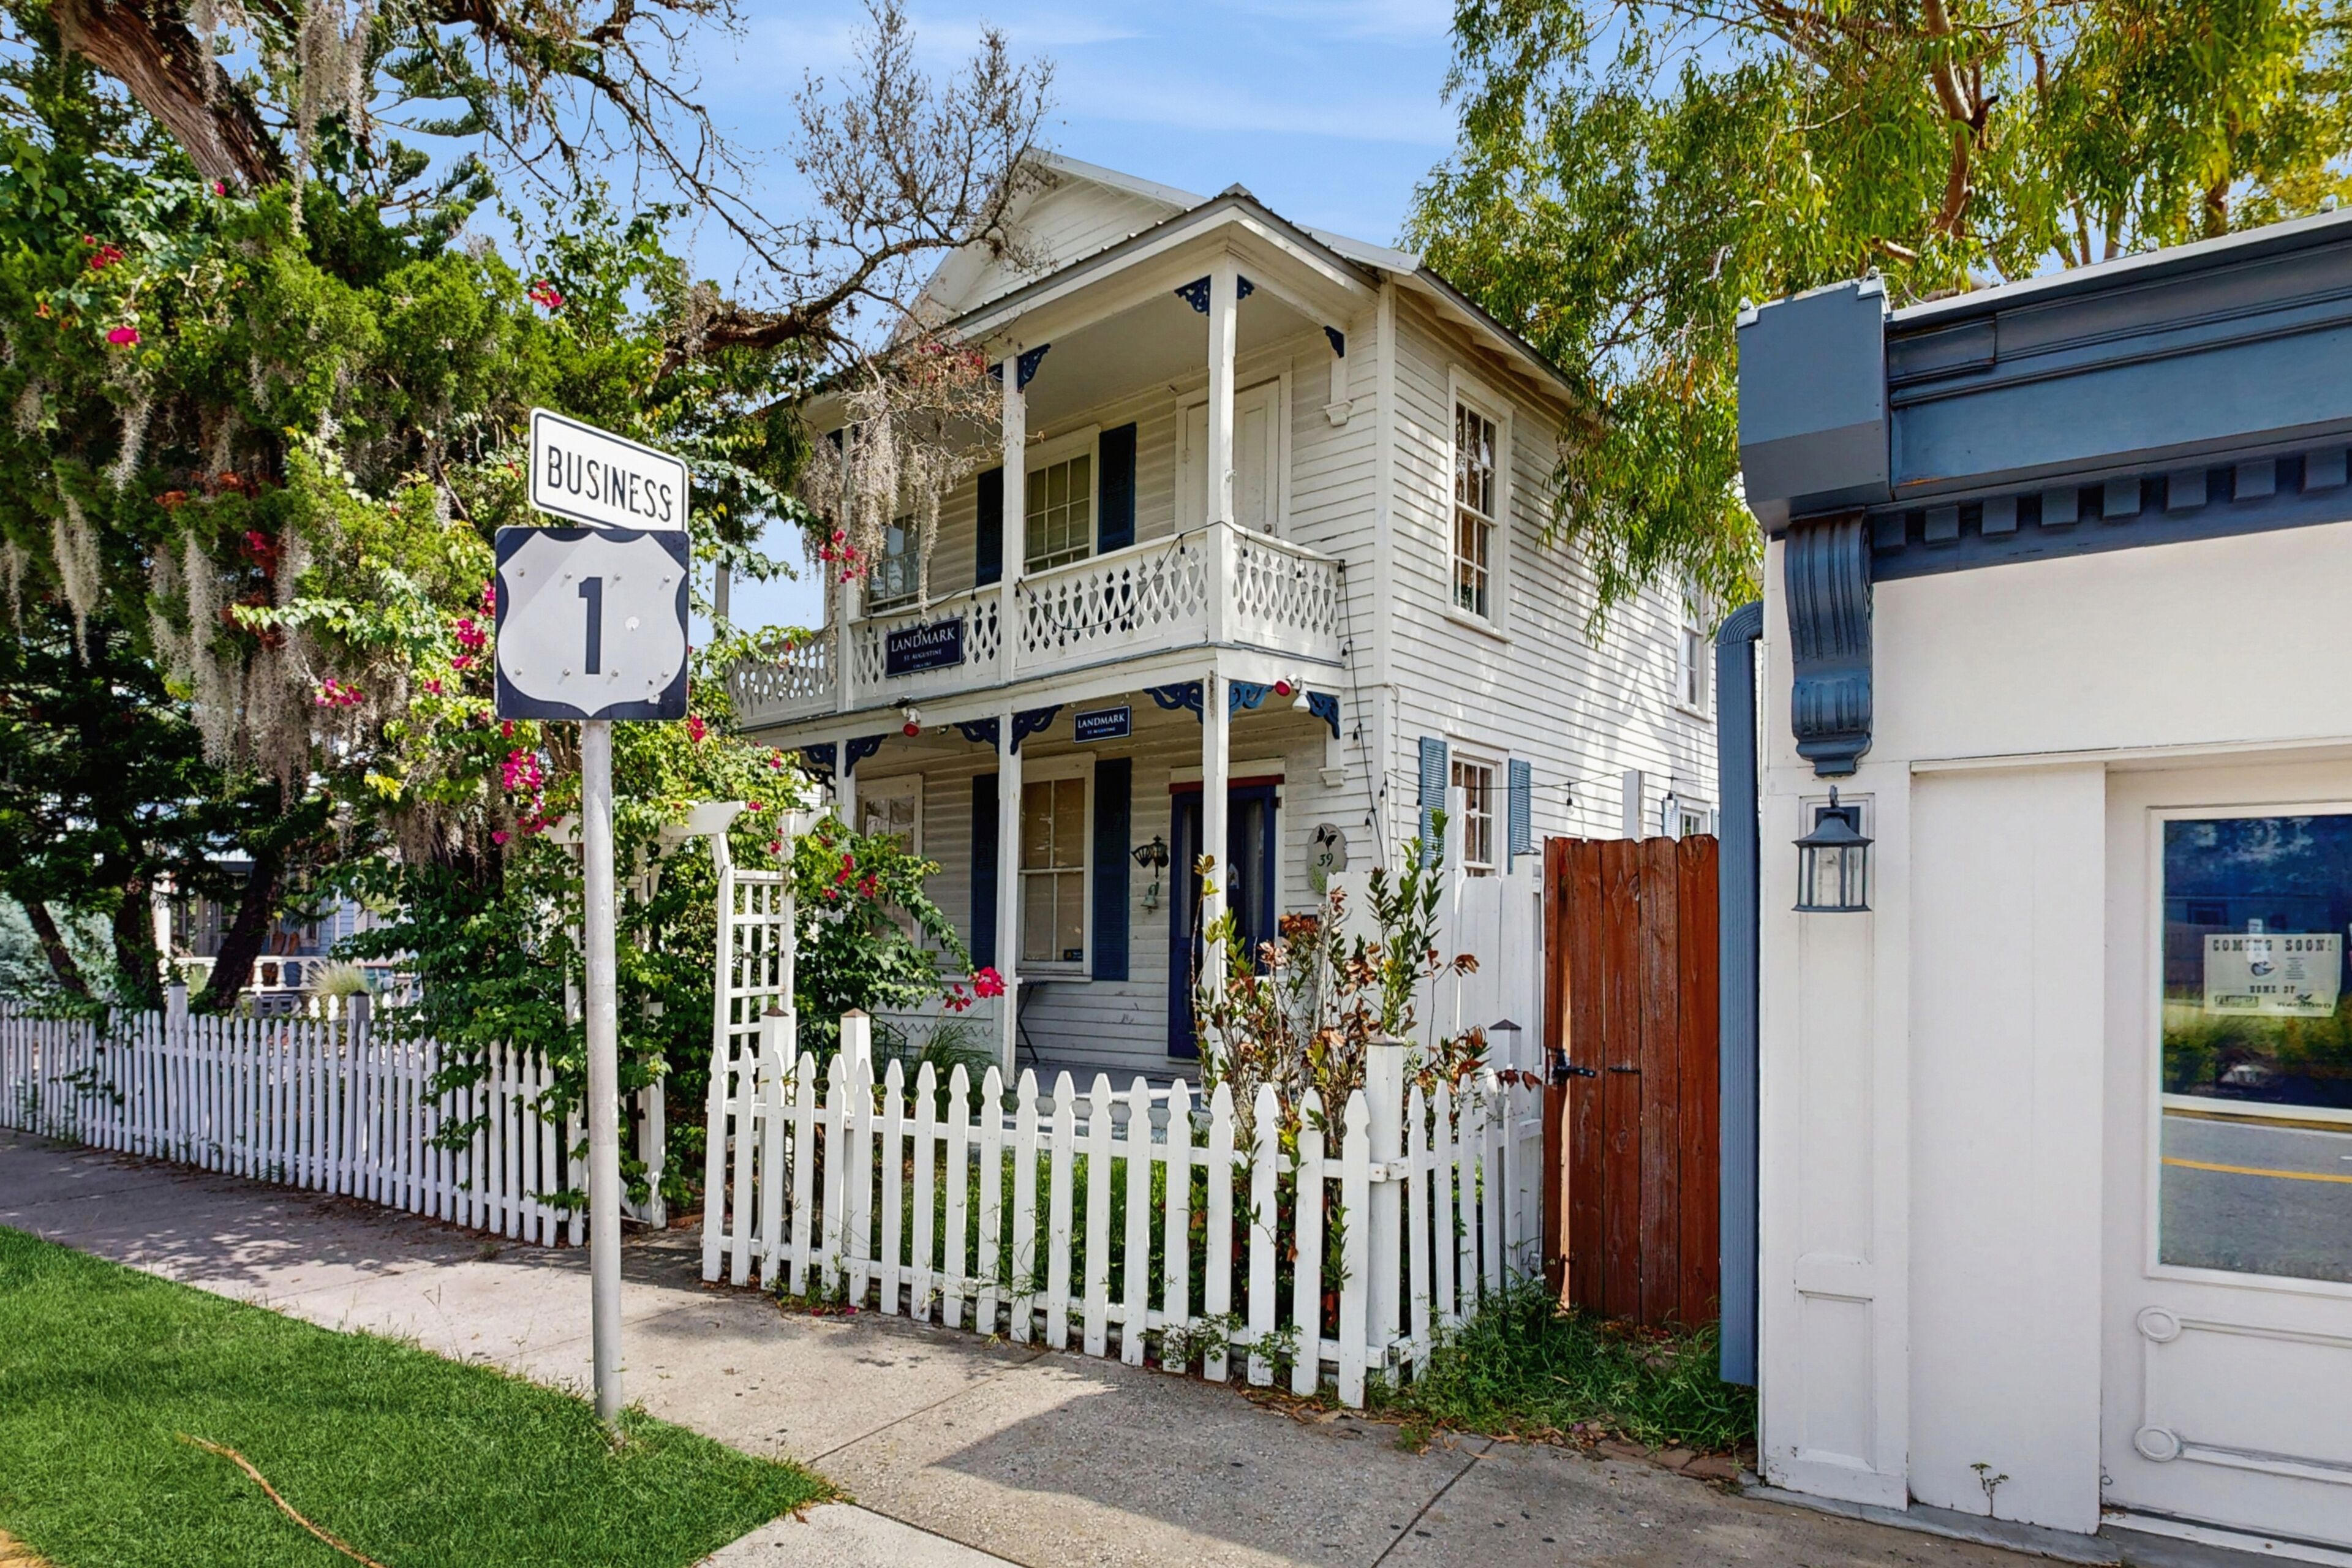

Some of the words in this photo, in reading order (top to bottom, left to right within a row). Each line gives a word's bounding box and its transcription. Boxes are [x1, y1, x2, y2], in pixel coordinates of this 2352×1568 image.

[548, 445, 671, 522] BUSINESS
[578, 576, 603, 675] 1
[891, 627, 956, 652] LANDMARK
[911, 648, 941, 660] AUGUSTINE
[1077, 712, 1125, 729] LANDMARK
[1317, 853, 1333, 867] 39
[2285, 939, 2332, 951] SOON!
